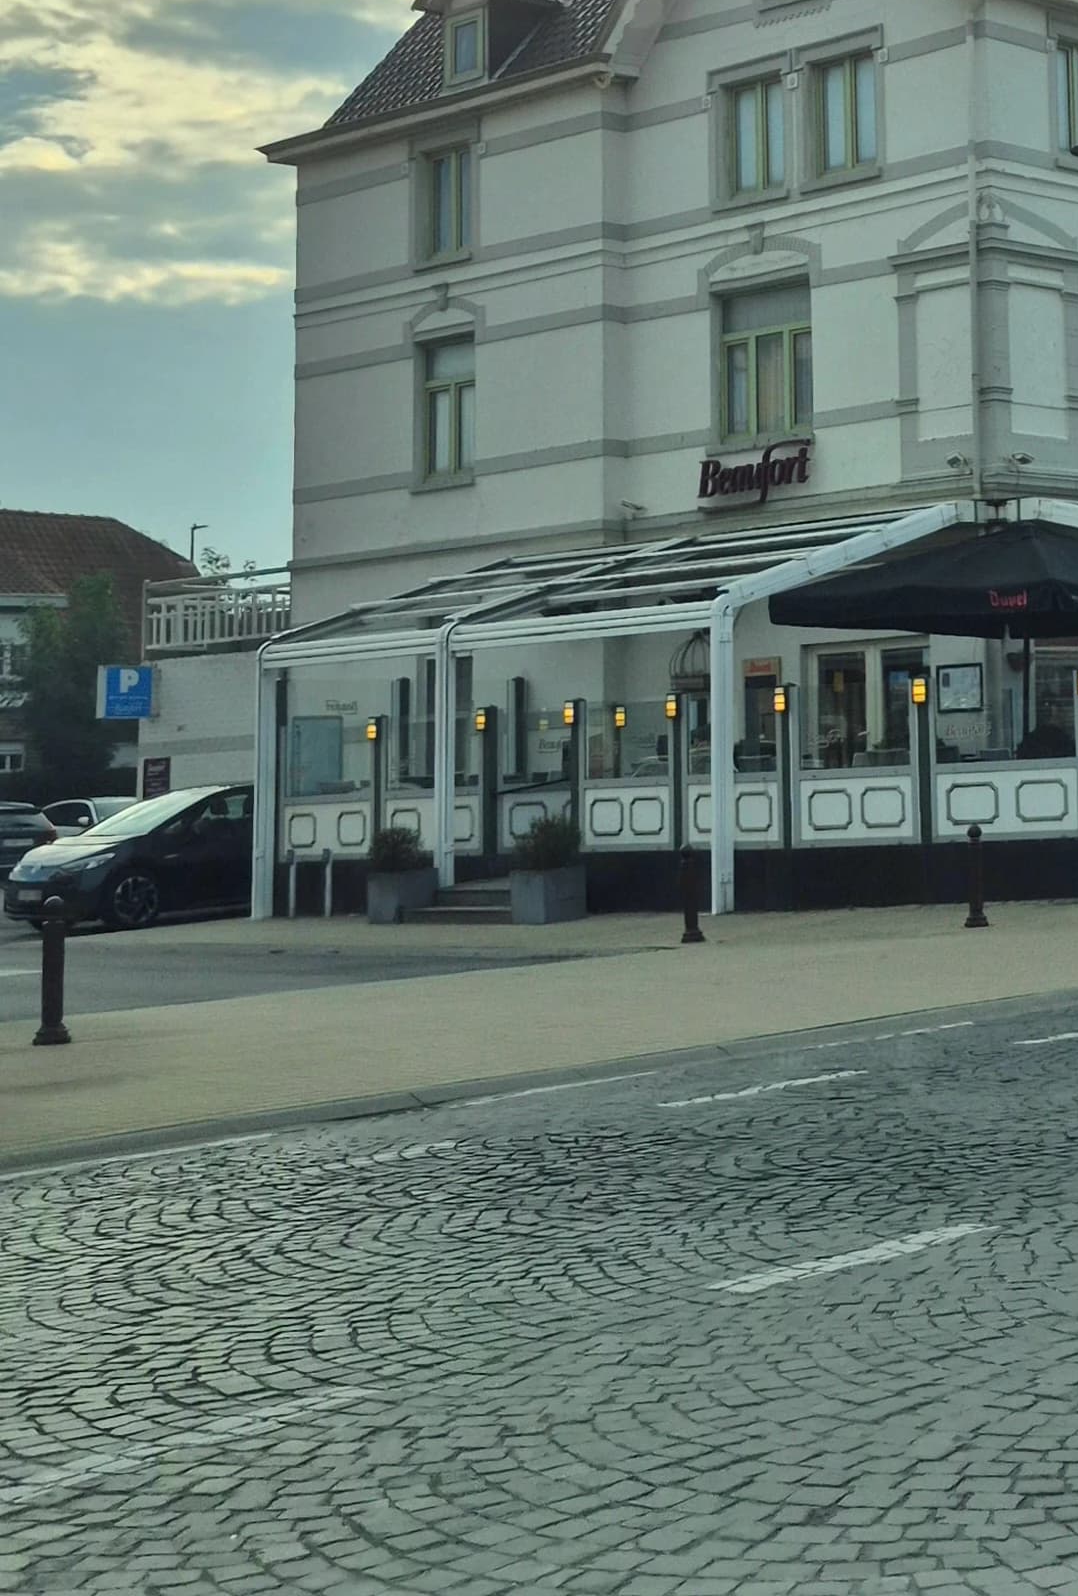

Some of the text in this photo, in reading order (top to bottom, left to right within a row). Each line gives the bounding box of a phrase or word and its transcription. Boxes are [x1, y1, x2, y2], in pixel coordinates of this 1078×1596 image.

[698, 438, 811, 503] Beaufort
[988, 588, 1027, 608] Duvel
[120, 668, 140, 693] P
